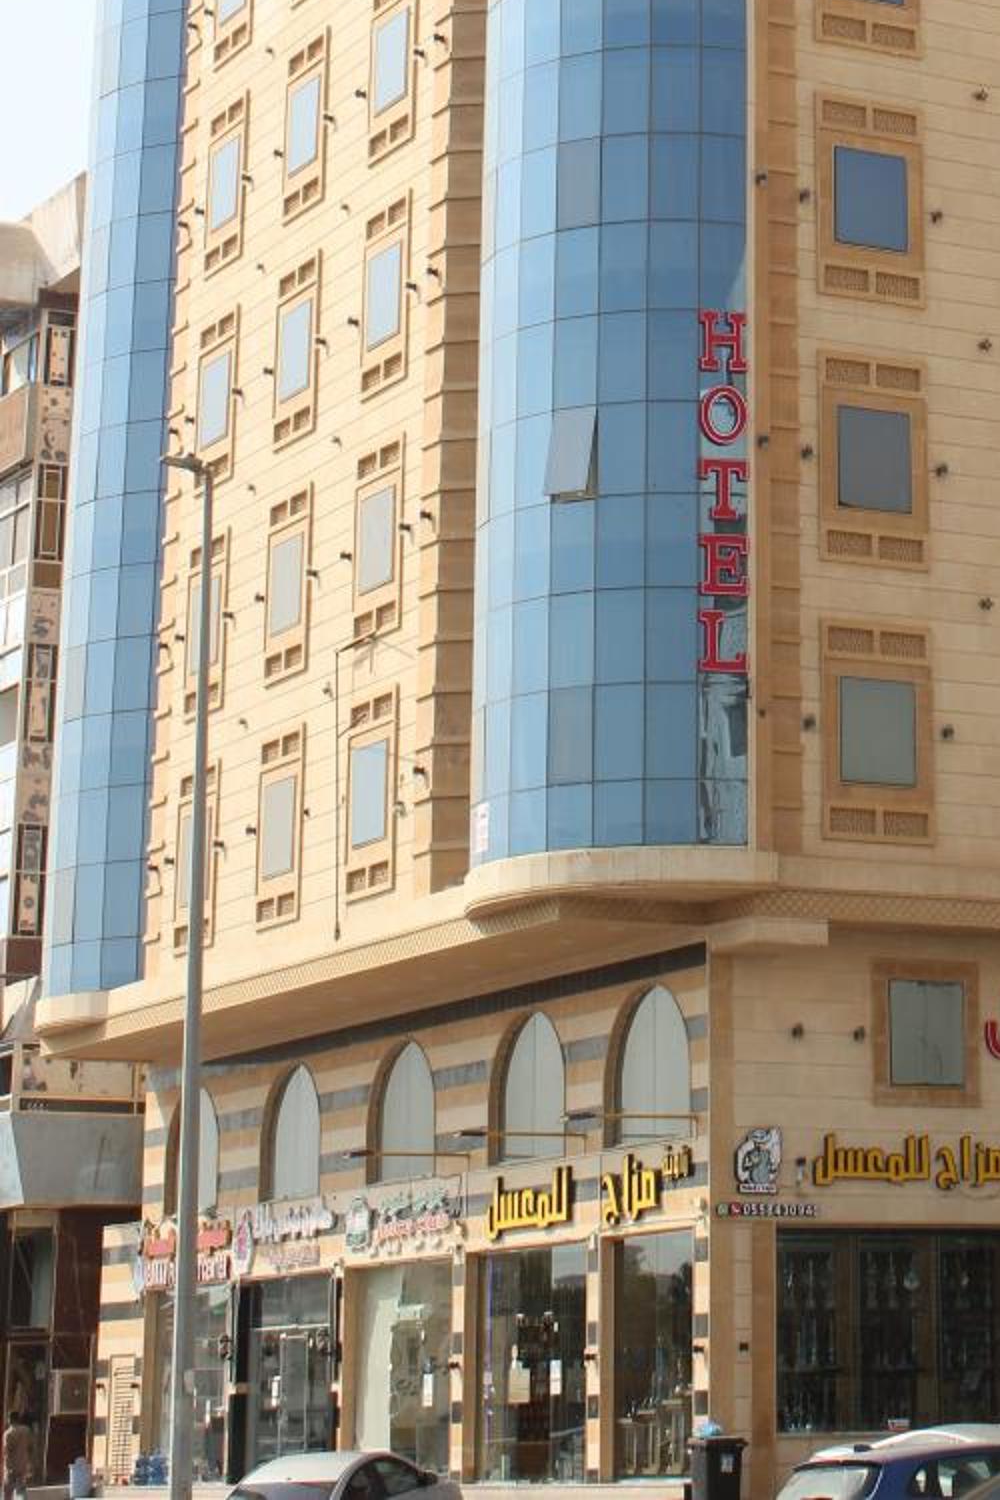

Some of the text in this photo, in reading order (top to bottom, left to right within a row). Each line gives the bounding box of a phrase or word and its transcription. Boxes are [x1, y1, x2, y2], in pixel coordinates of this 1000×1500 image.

[698, 310, 749, 674] HOTEL
[602, 1153, 658, 1226] مزاج
[813, 1132, 930, 1186] للمعسل
[483, 1165, 570, 1240] للمعسل
